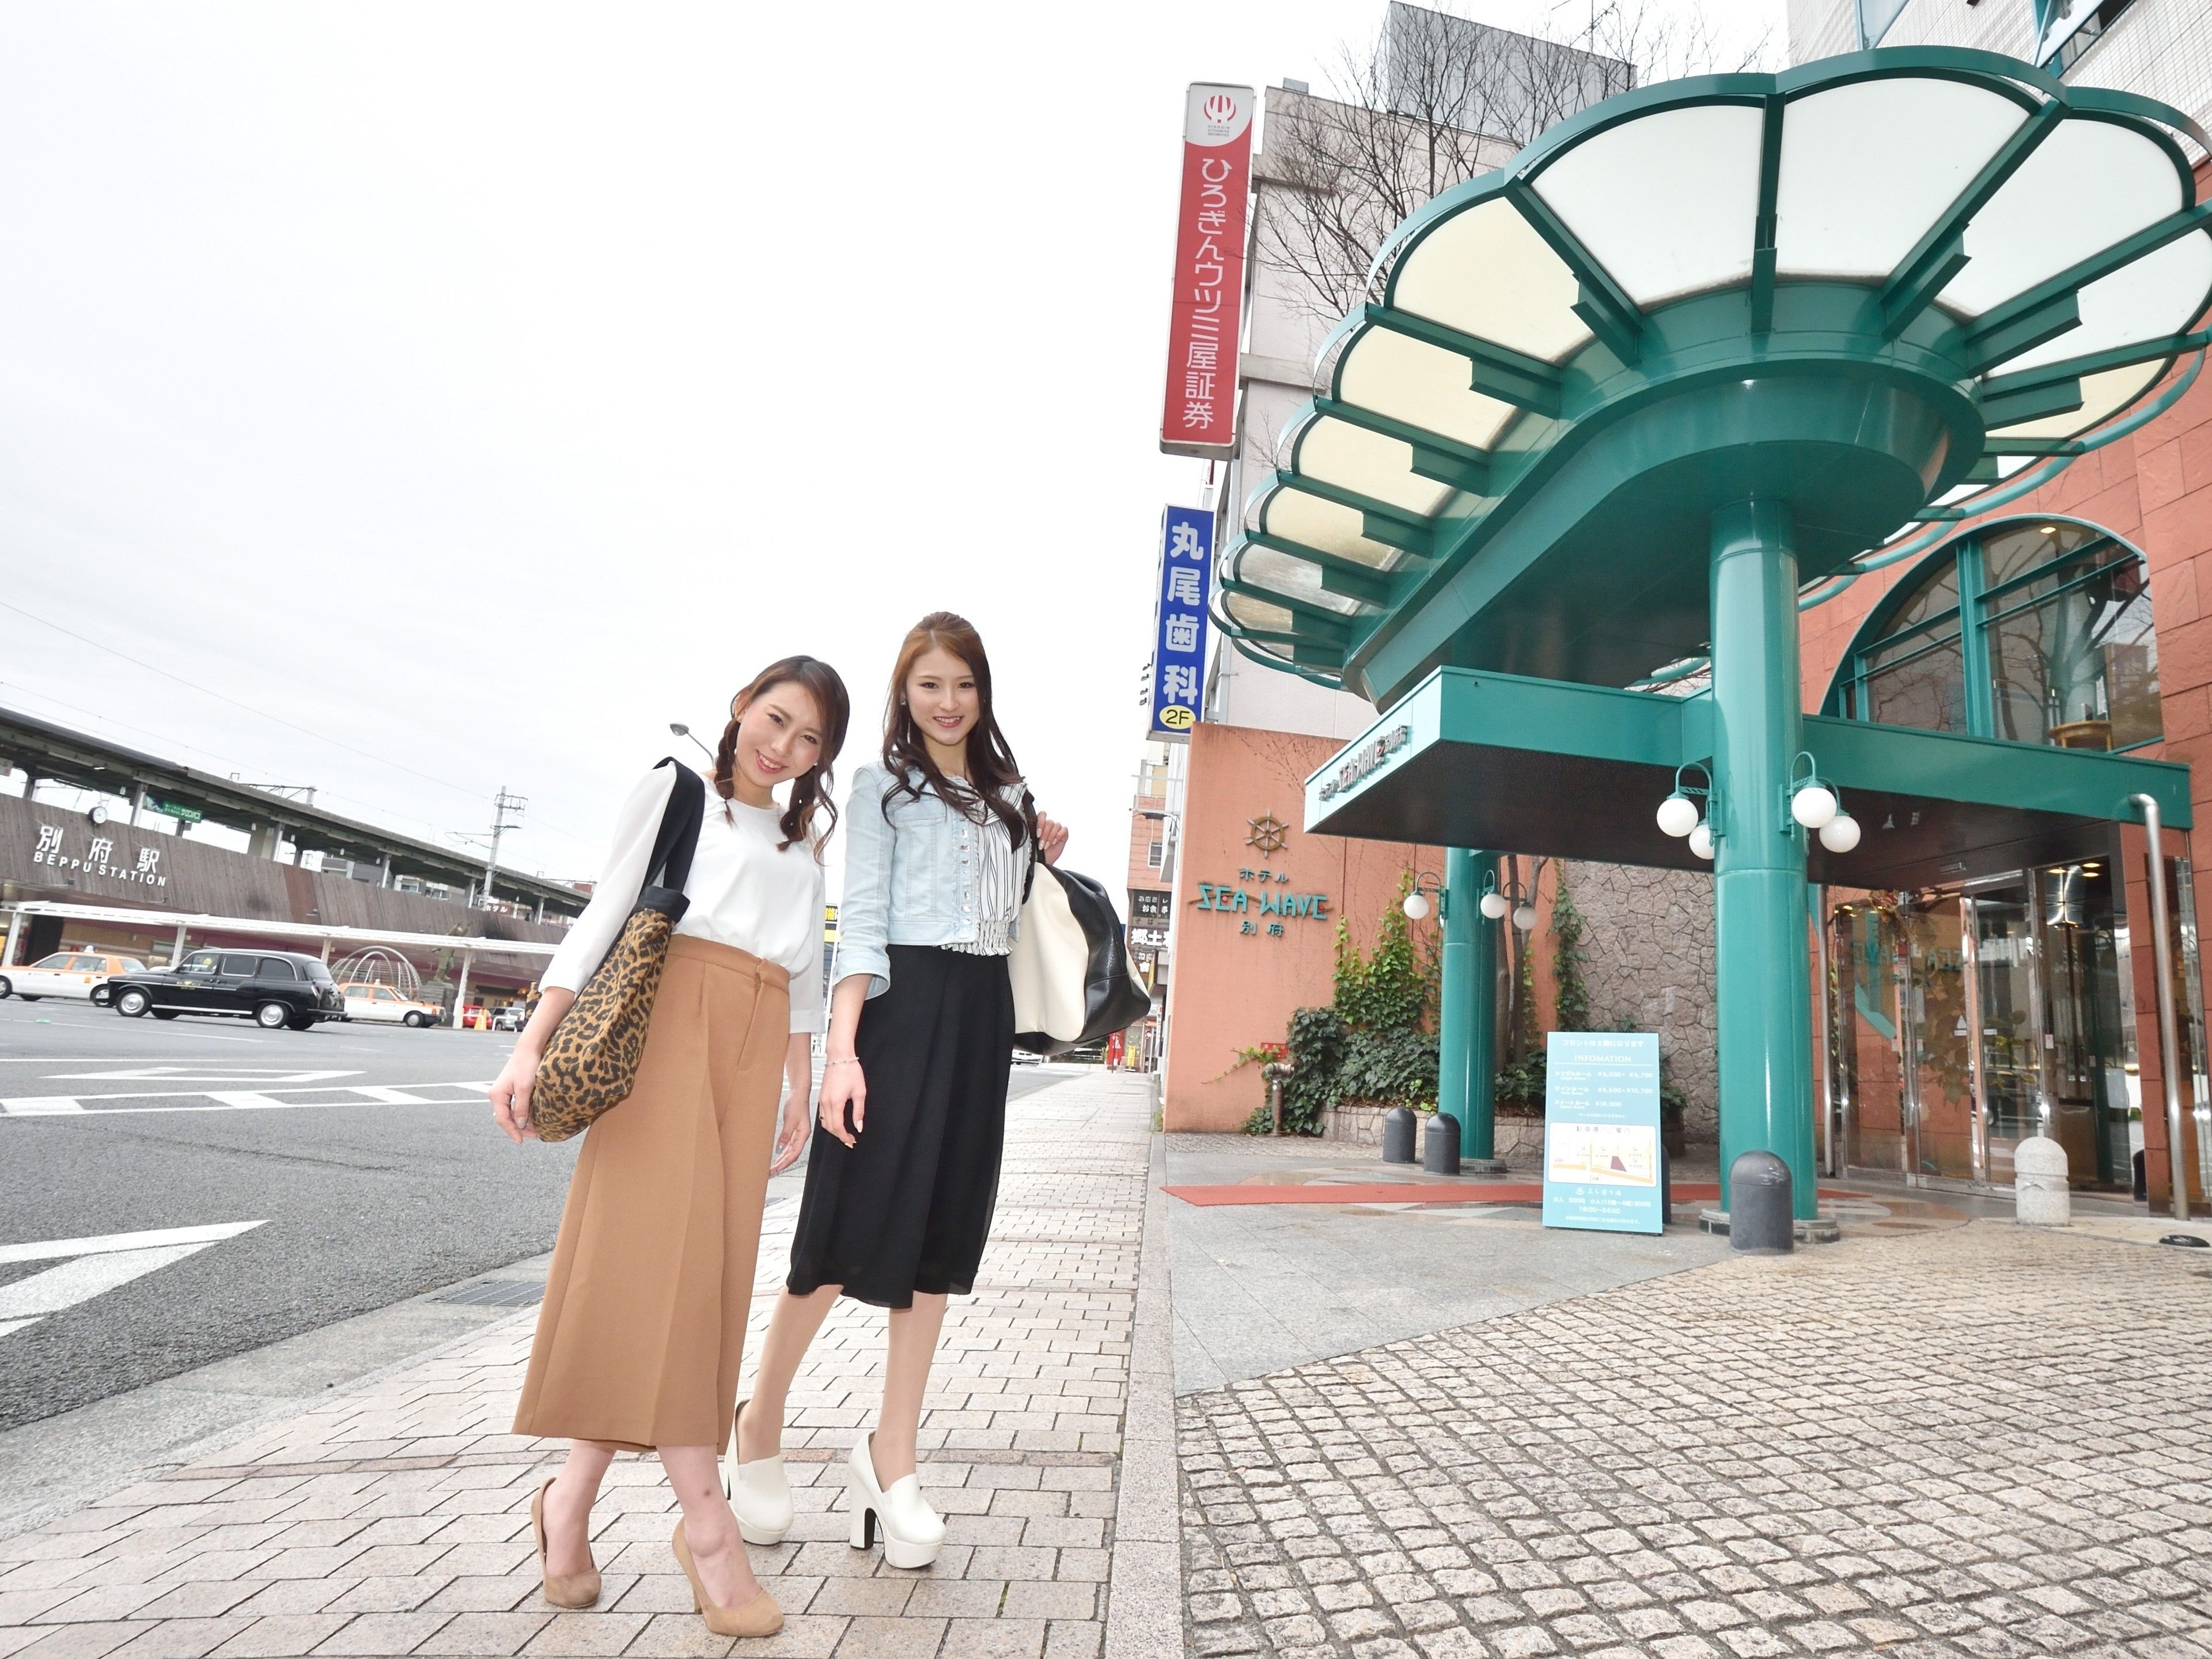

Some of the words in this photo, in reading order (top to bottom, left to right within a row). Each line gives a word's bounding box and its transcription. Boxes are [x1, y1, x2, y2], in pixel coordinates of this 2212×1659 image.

[1183, 158, 1233, 429] ひろぎんウツミ屋証券
[1162, 521, 1204, 706] 丸尾歯科
[1166, 710, 1190, 725] 2F
[36, 824, 160, 873] 別府駅
[34, 851, 92, 873] BEPPU
[98, 864, 166, 887] STATION
[1240, 868, 1289, 883] ホテル
[1197, 883, 1248, 912] SEA
[1259, 891, 1328, 920] WAVE
[1240, 920, 1284, 937] 別府
[1574, 1055, 1632, 1063] INFOMATION
